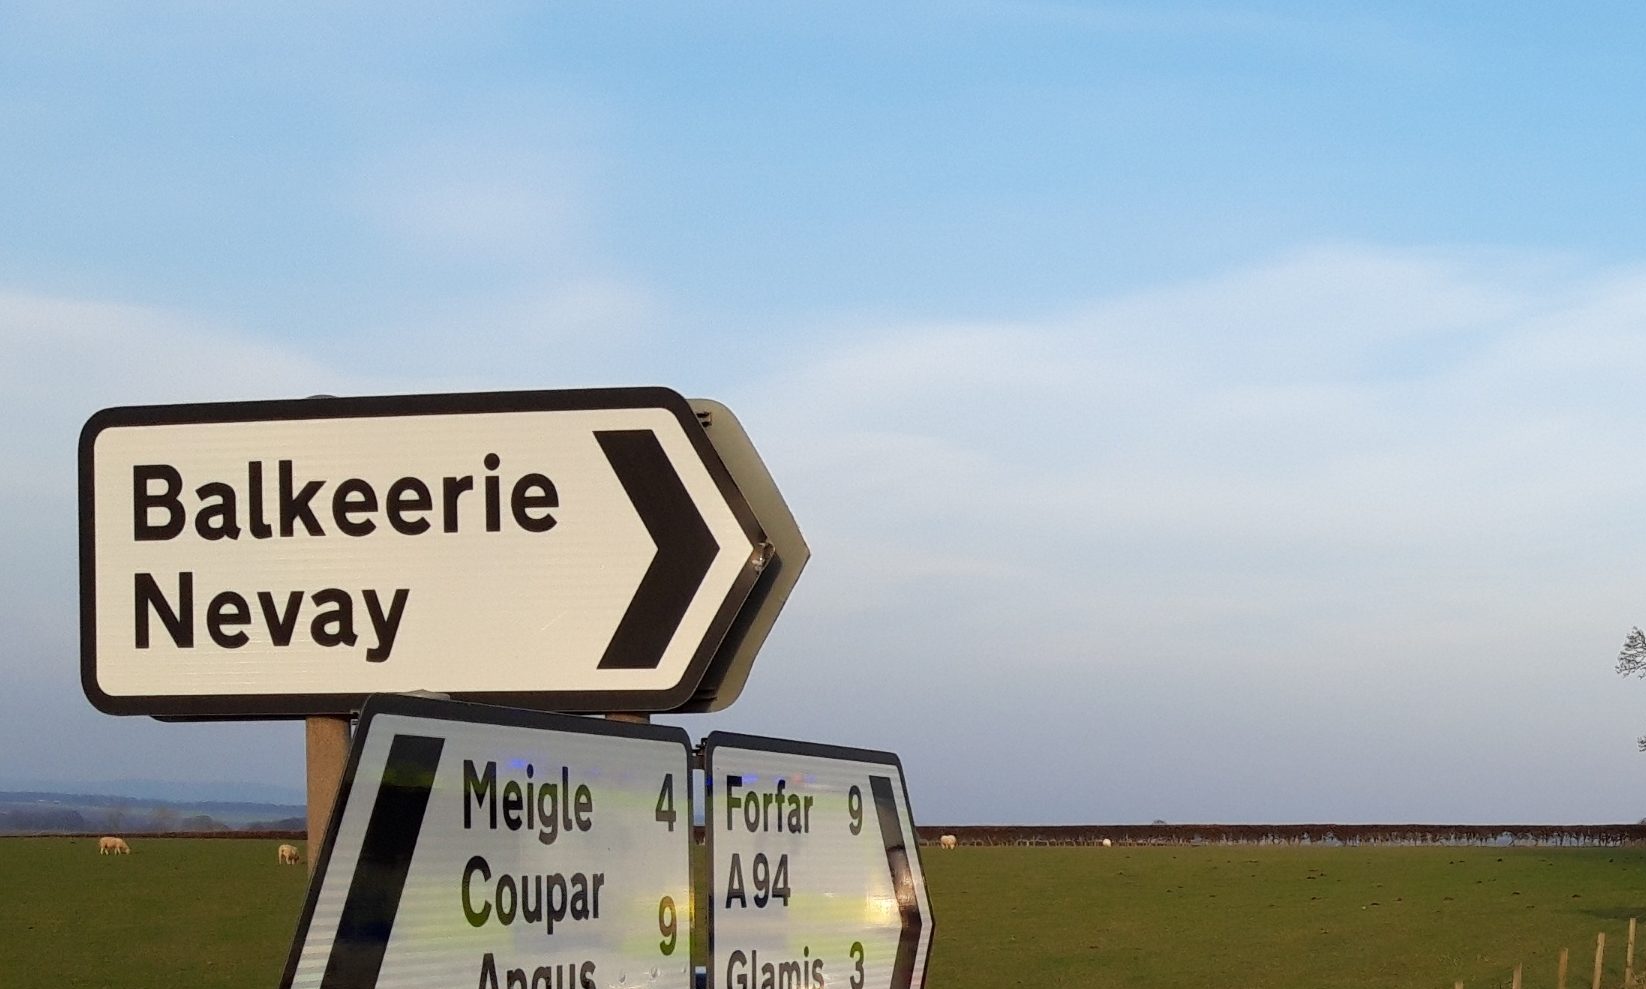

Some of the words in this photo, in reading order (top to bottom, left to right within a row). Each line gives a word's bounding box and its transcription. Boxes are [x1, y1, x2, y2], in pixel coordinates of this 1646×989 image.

[132, 453, 560, 542] Balkeerie
[133, 570, 410, 663] Nevay
[462, 759, 593, 845] Meigle
[655, 772, 677, 832] 4
[725, 775, 814, 835] Forfar
[847, 785, 863, 836] 9
[461, 855, 605, 935] Coupar
[724, 852, 791, 910] A94
[658, 895, 678, 957] 9
